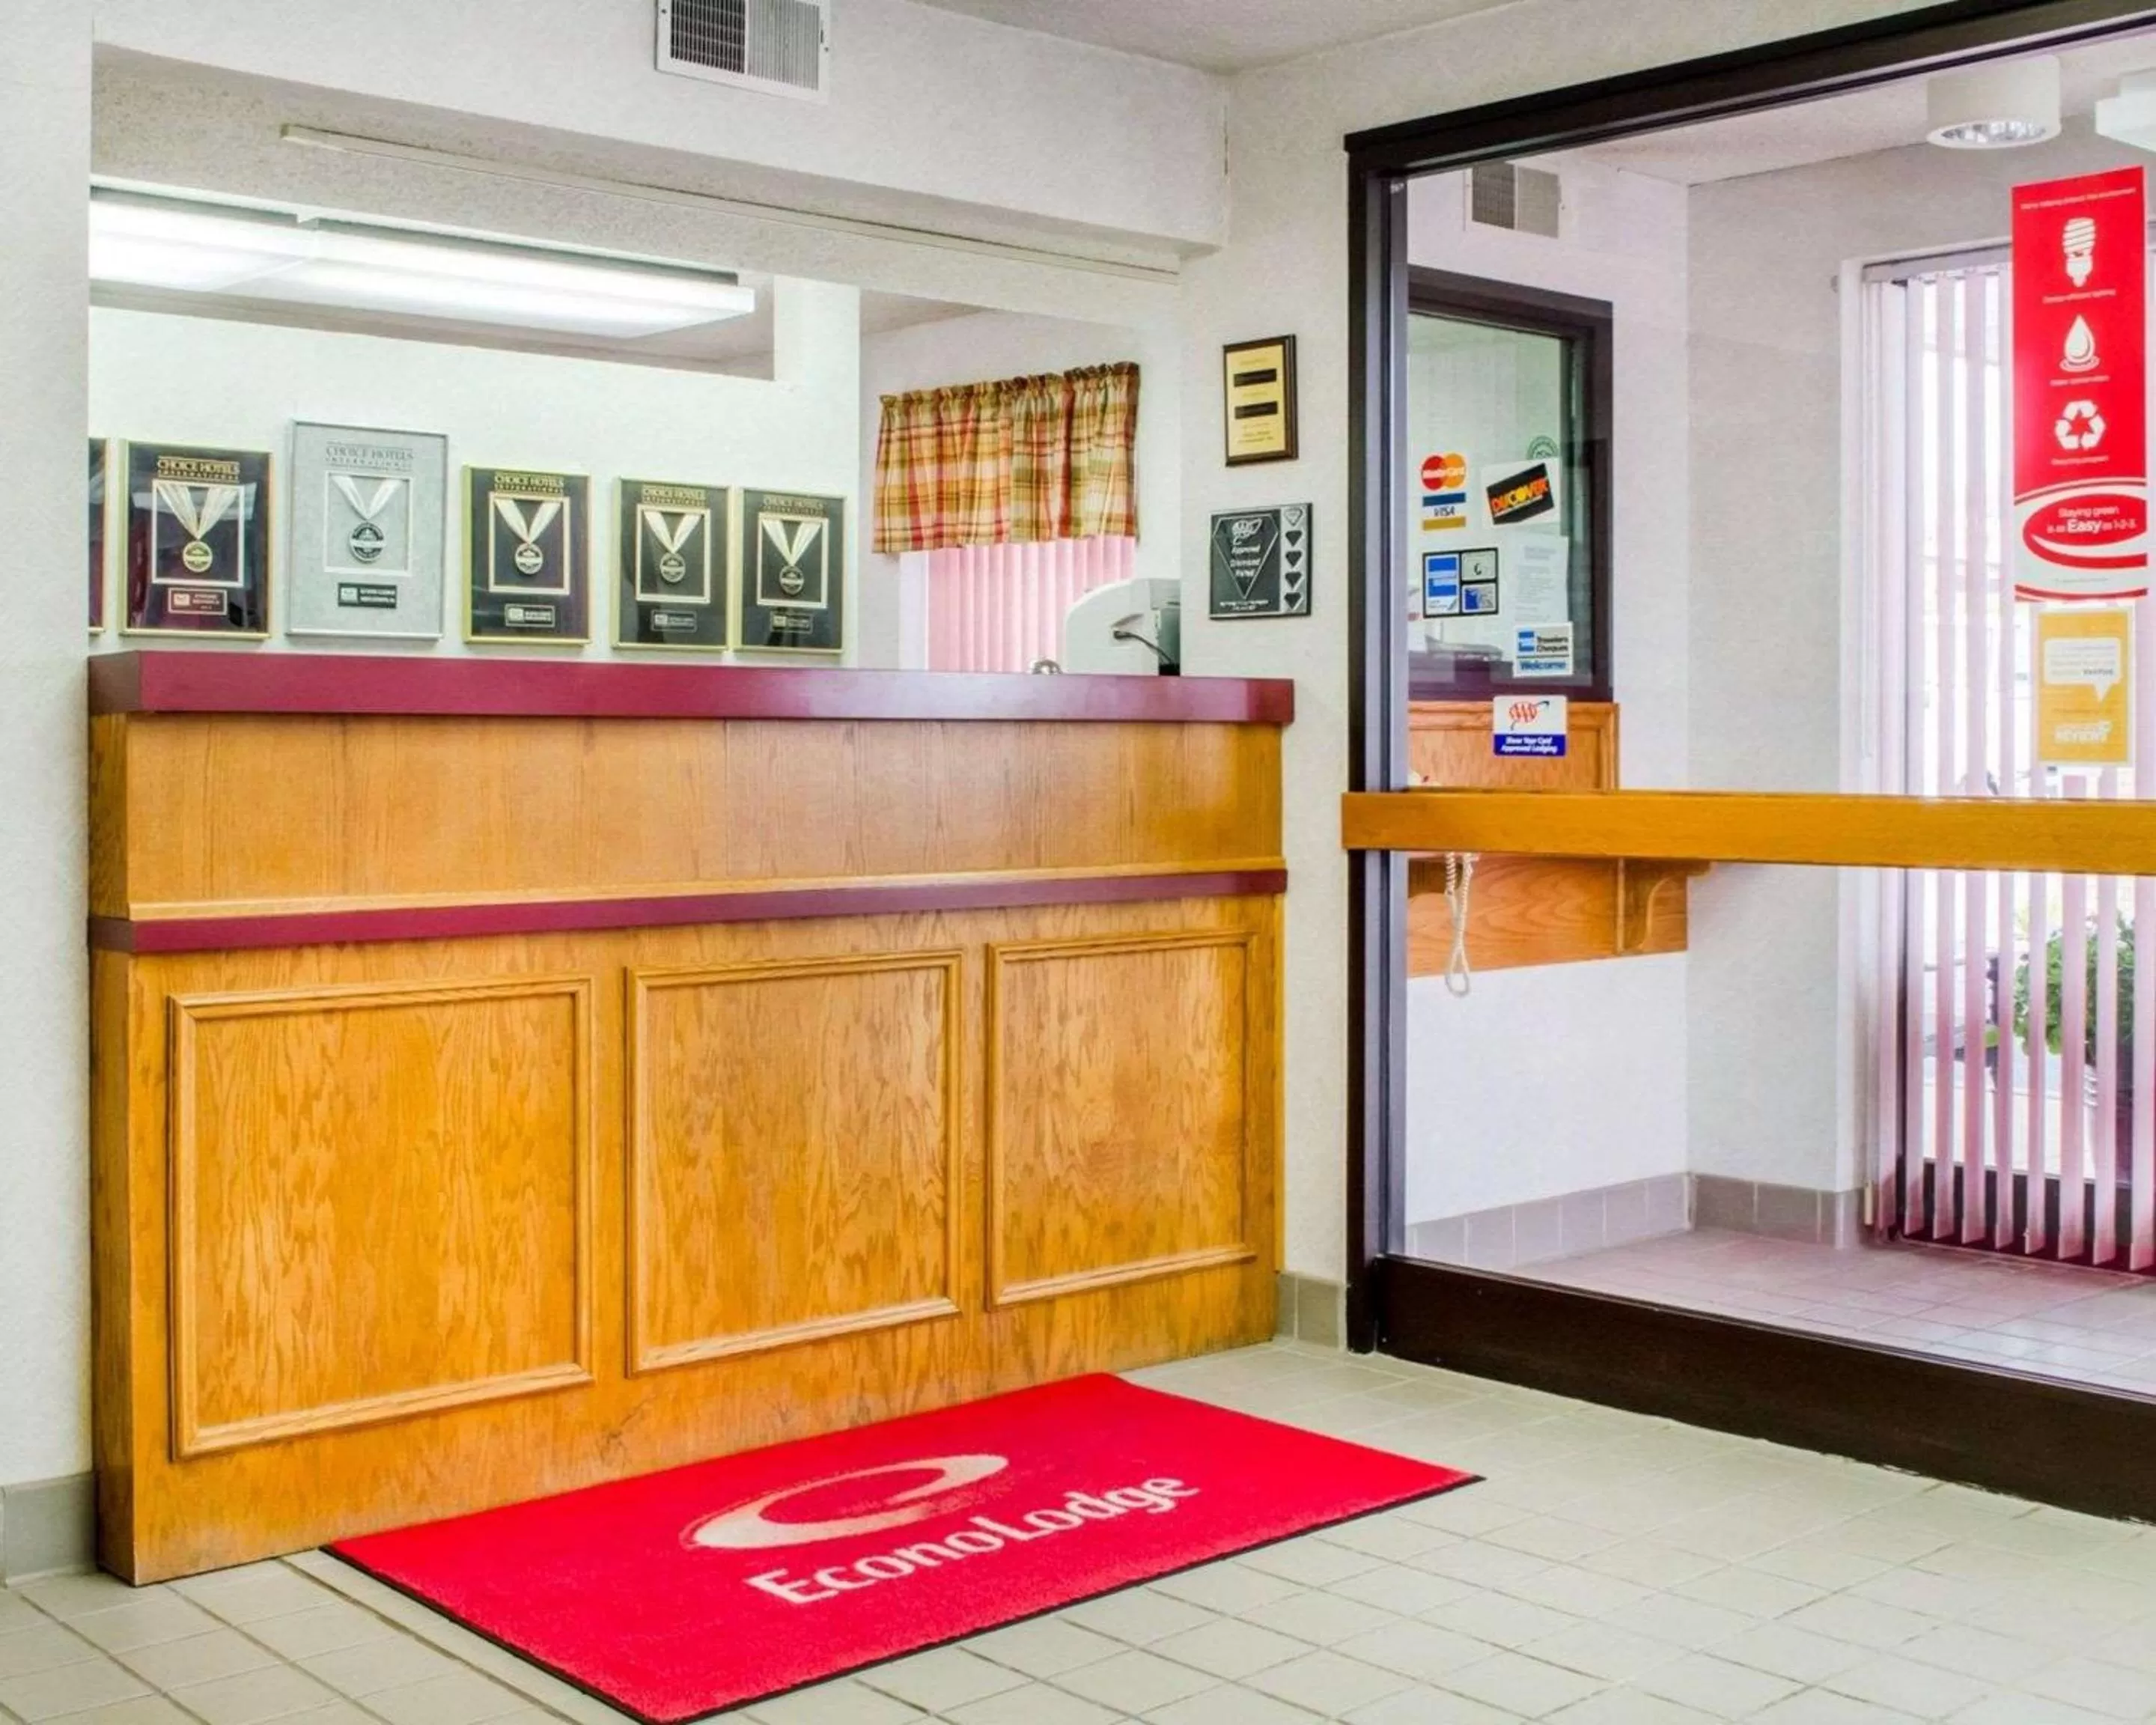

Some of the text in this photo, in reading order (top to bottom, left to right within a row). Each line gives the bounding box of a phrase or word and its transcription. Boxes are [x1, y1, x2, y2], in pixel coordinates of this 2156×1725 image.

[1434, 505, 1456, 517] VISA
[2058, 507, 2119, 518] Staying green
[2067, 519, 2102, 535] Easy
[1520, 659, 1566, 670] Welcome
